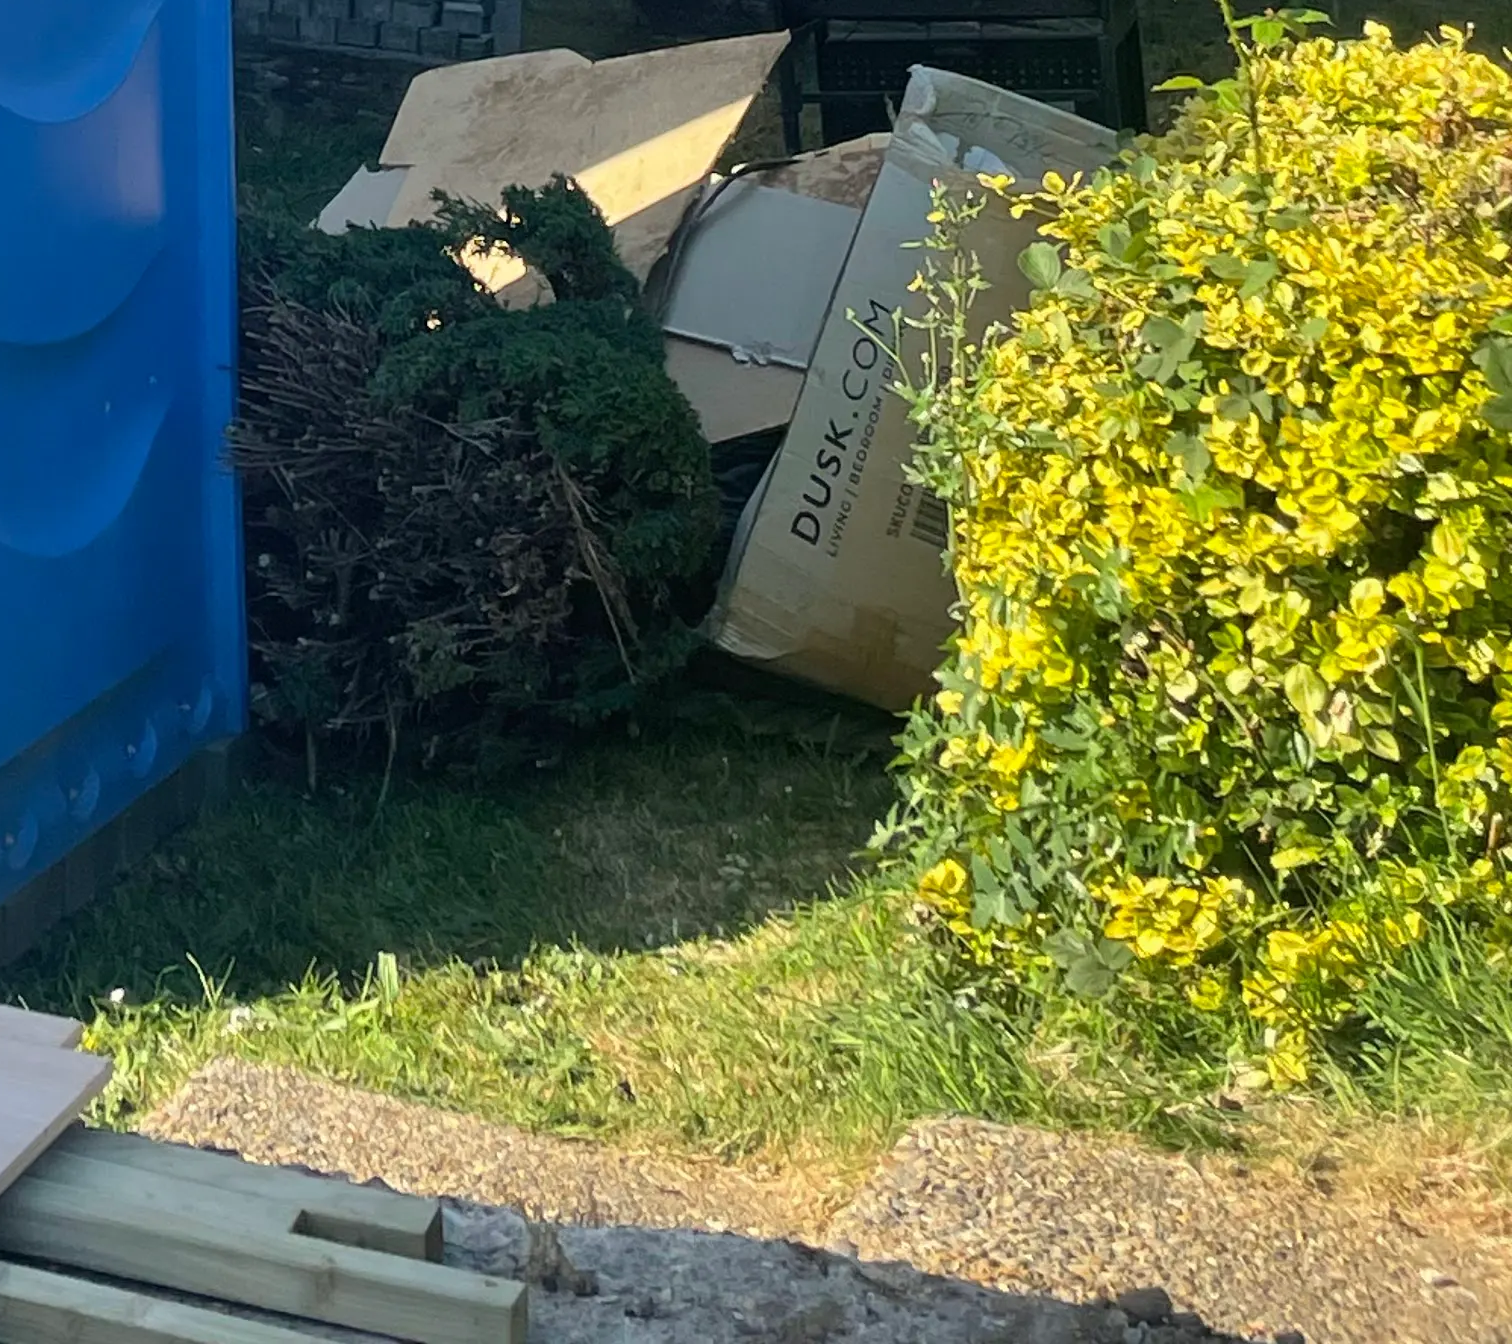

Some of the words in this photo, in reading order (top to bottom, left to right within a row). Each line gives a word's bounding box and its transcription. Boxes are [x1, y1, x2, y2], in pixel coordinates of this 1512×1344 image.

[790, 299, 891, 546] DUSK.COM
[826, 500, 853, 558] LIVING
[849, 395, 883, 486] BEDROOM
[886, 483, 914, 539] SKUCO
